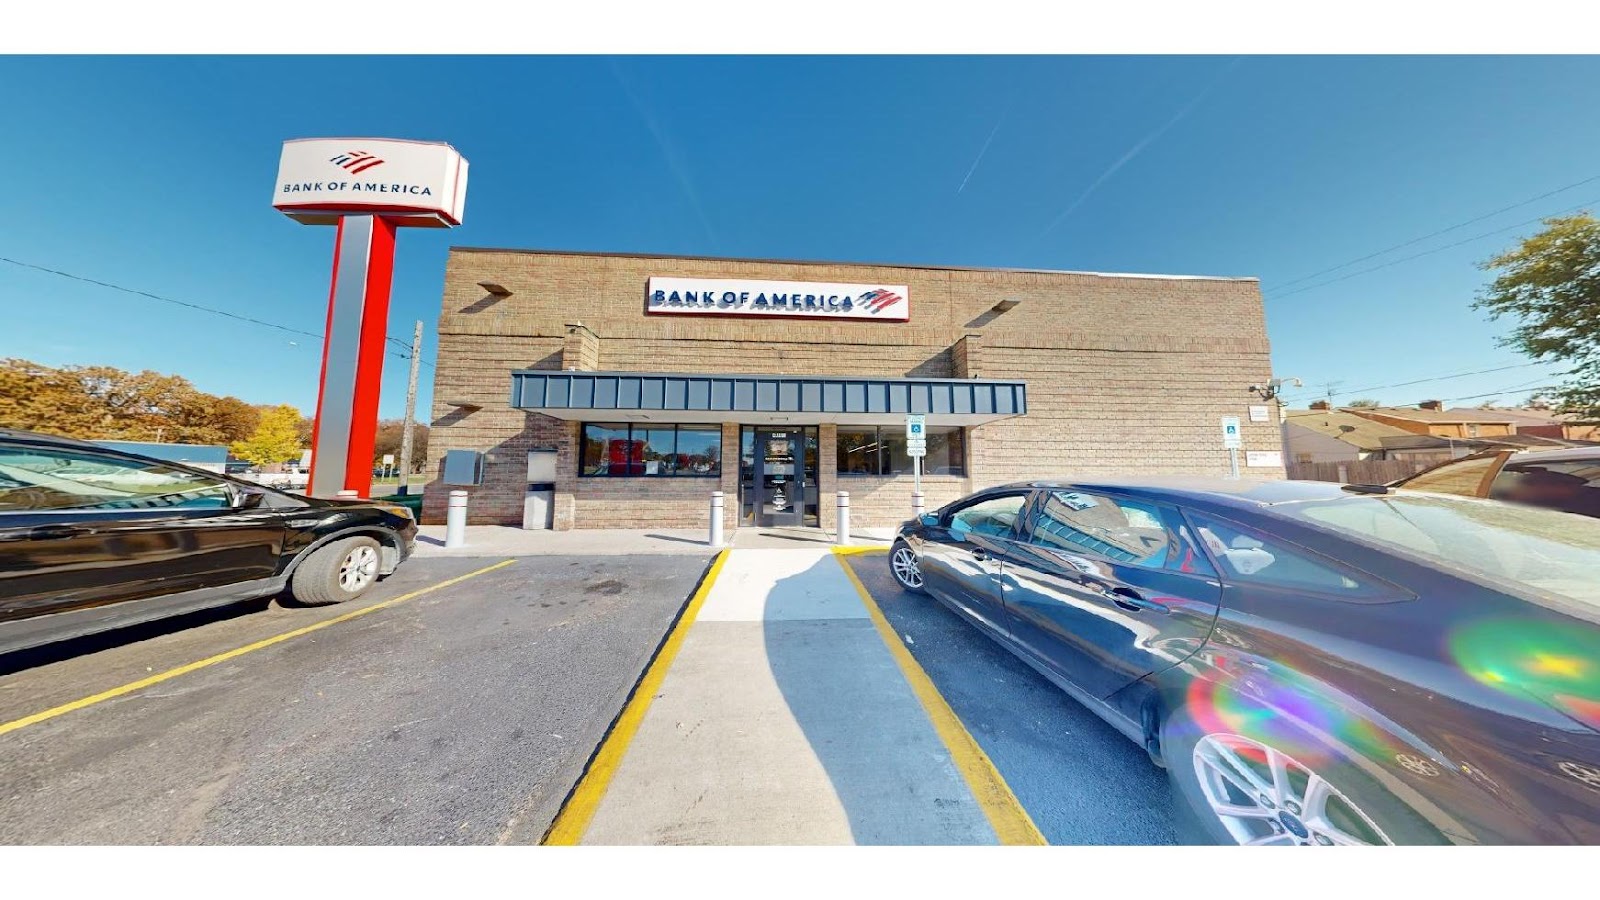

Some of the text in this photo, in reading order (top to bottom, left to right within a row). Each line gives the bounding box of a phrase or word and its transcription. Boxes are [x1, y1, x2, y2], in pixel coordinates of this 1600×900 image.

[283, 181, 432, 196] BANK OF AMERICA
[655, 290, 853, 308] BANK OF AMERICA
